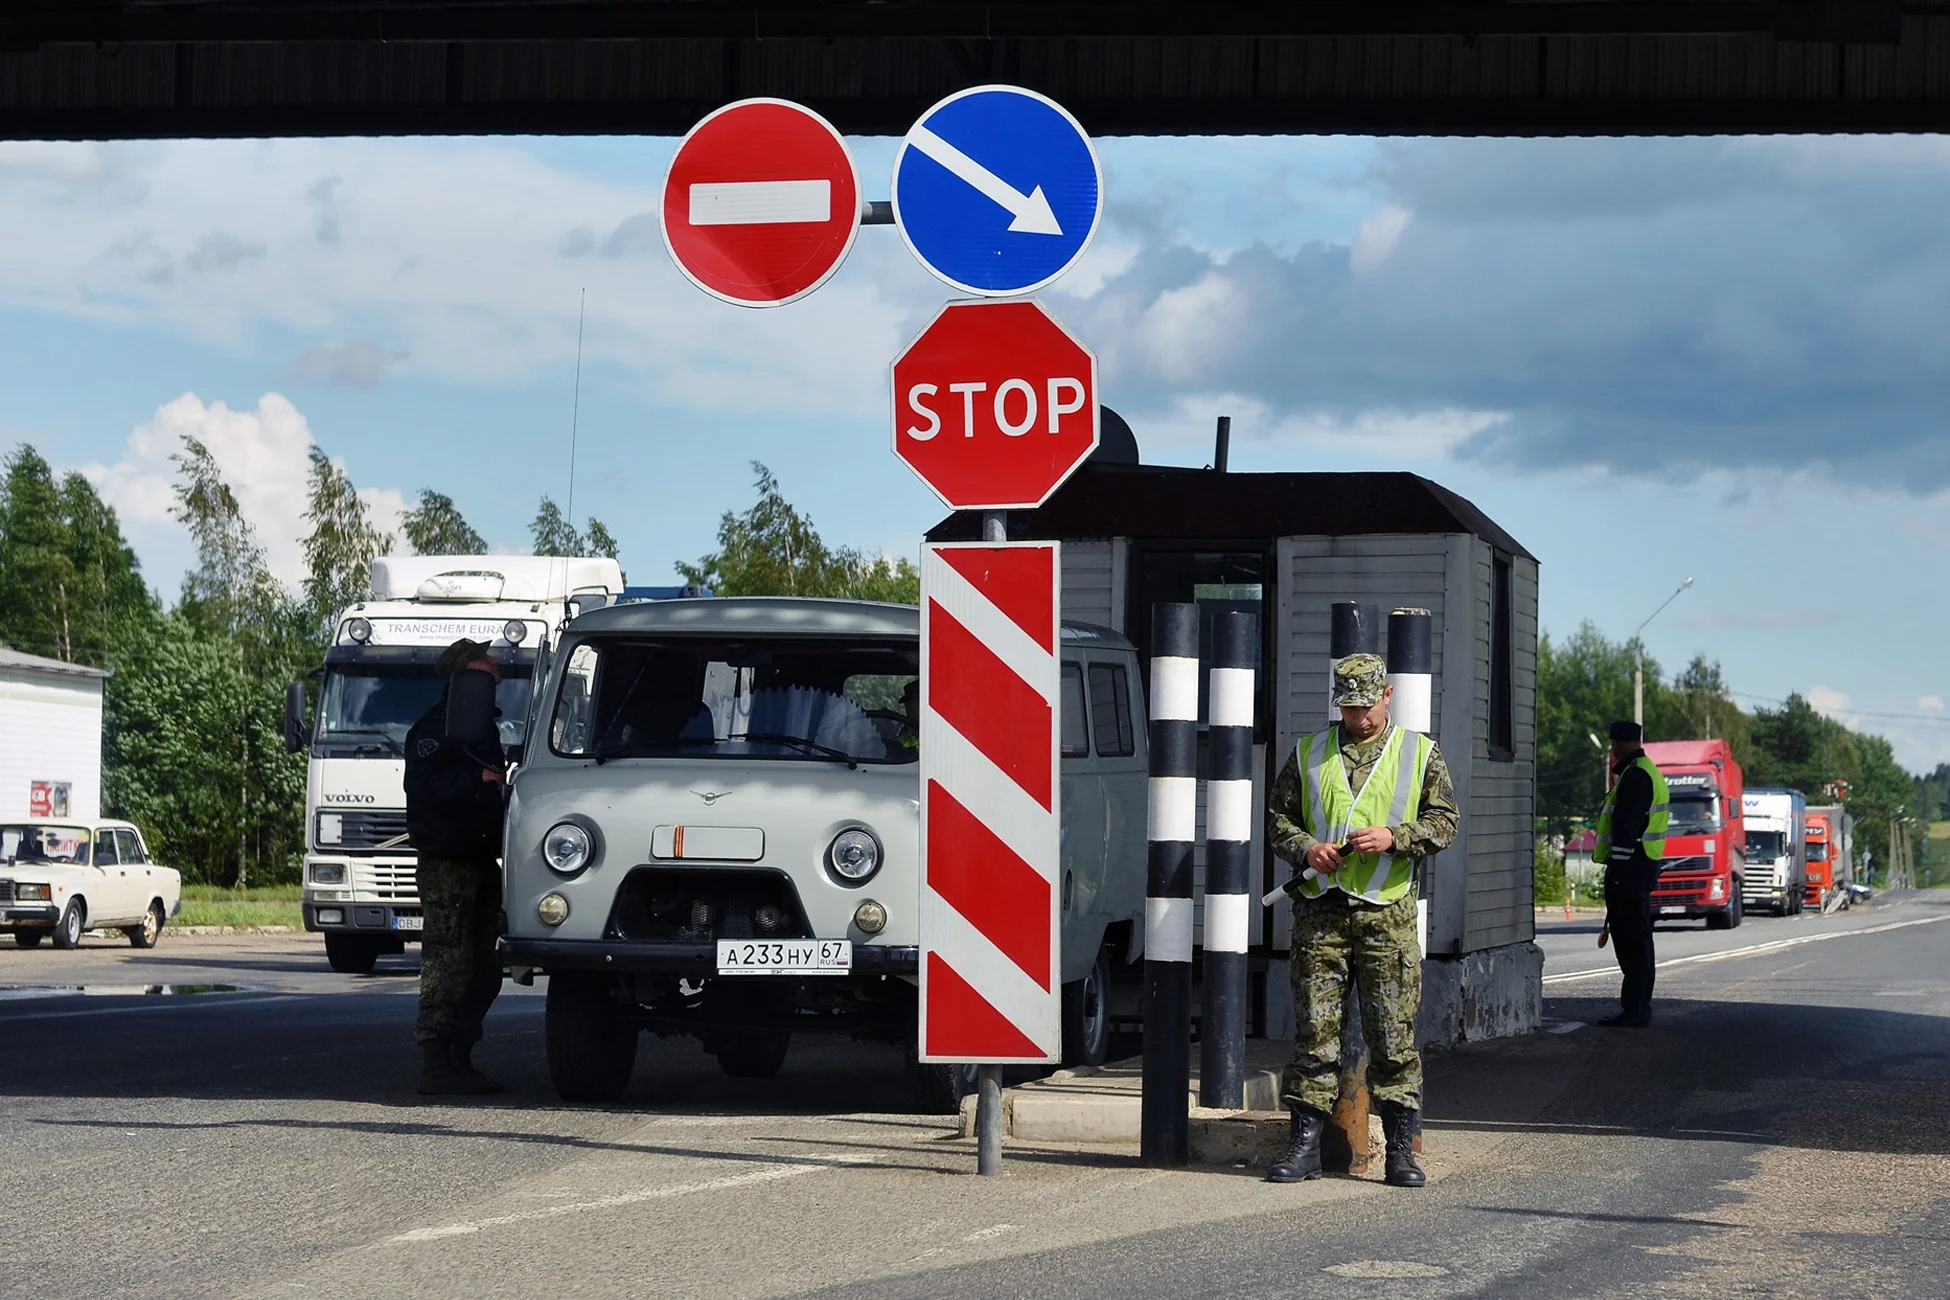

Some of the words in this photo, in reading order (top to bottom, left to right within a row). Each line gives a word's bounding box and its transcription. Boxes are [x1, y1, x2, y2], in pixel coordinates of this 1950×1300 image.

[907, 377, 1085, 441] STOP
[387, 623, 468, 634] TRANSCHEM
[324, 794, 376, 804] VOLVO
[821, 942, 843, 959] 67
